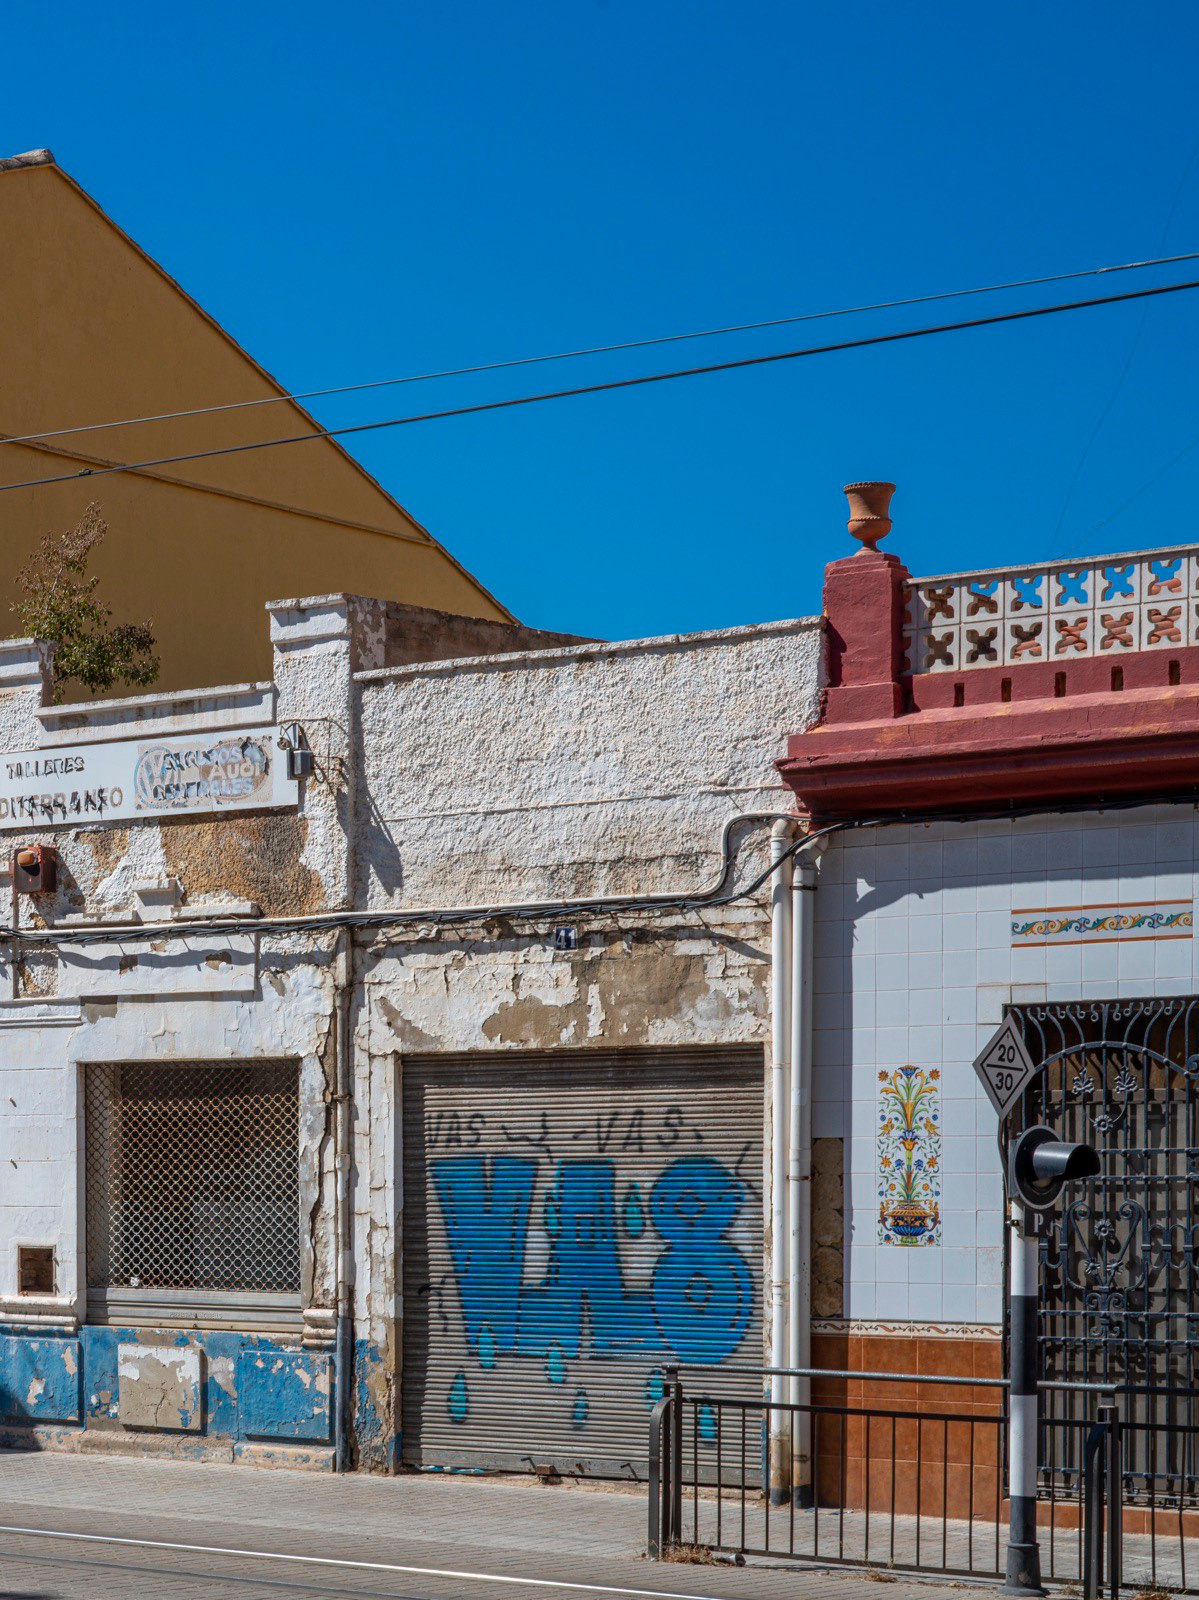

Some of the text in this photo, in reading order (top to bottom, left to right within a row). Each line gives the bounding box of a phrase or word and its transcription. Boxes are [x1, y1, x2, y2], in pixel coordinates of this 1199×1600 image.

[556, 929, 577, 949] 41
[997, 1044, 1016, 1063] 20
[995, 1072, 1014, 1091] 30
[1033, 1213, 1044, 1233] P
